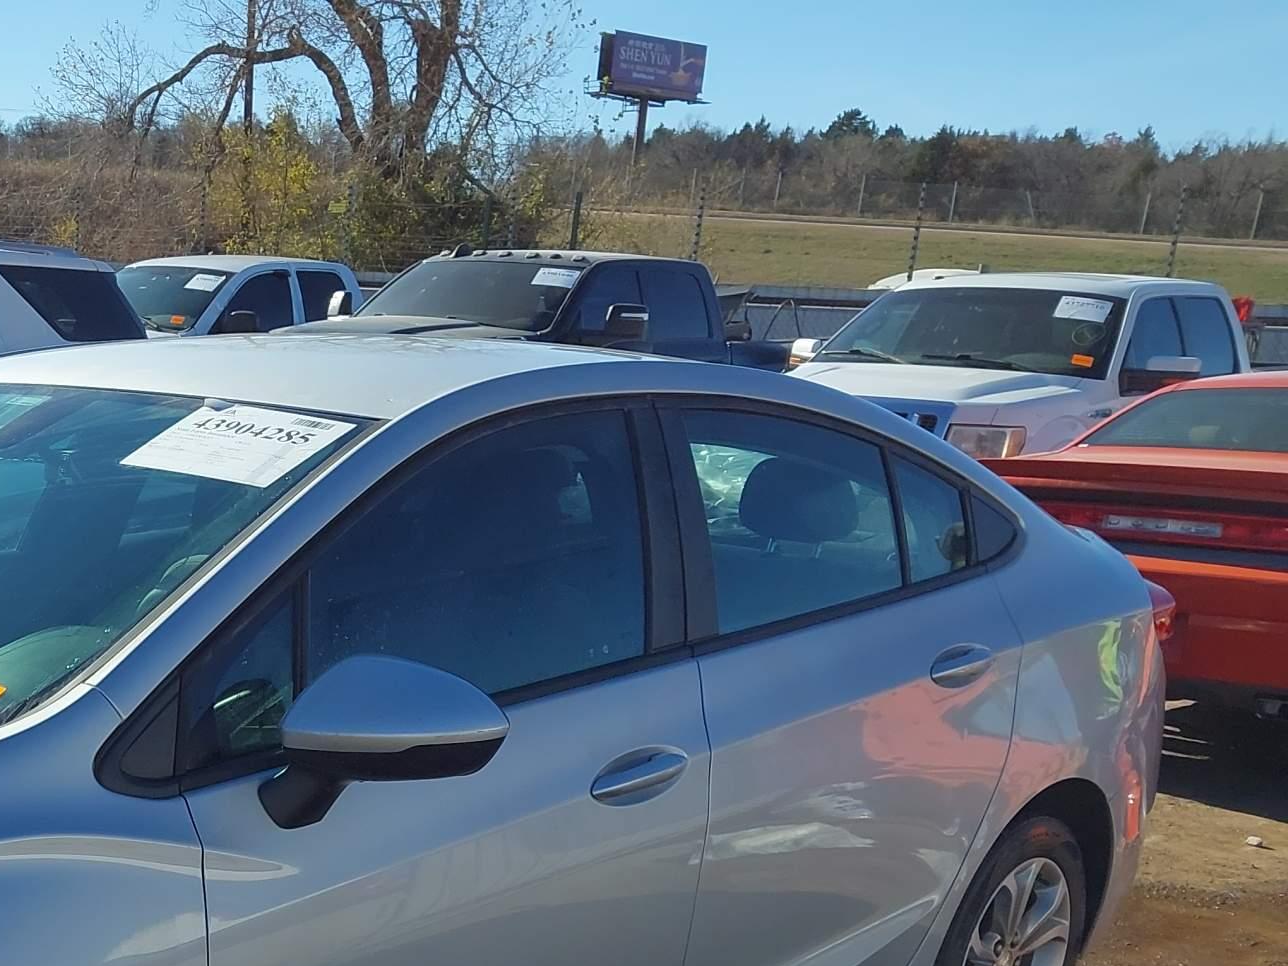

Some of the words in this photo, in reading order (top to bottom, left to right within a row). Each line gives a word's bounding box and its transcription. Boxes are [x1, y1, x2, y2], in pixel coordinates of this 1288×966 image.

[620, 47, 647, 62] SHEN
[650, 50, 672, 65] YUN
[192, 417, 317, 445] 43904285
